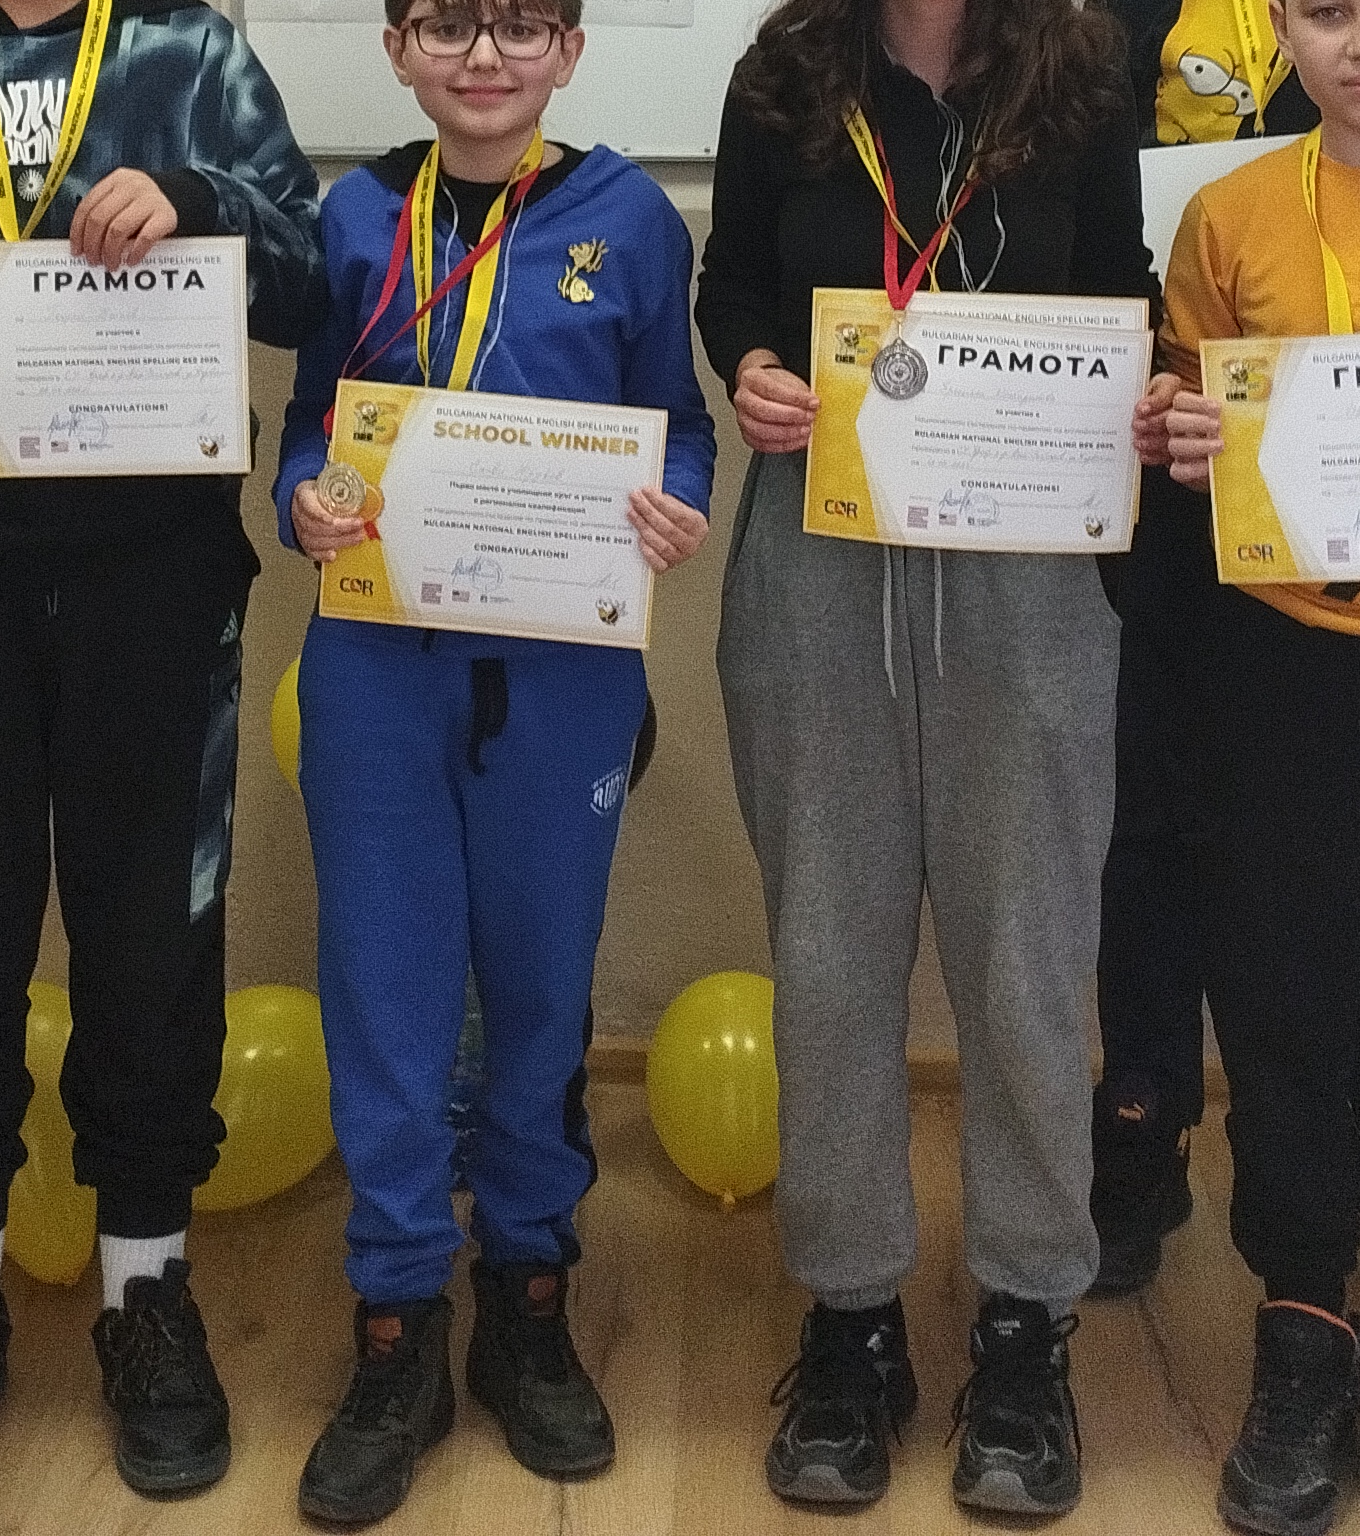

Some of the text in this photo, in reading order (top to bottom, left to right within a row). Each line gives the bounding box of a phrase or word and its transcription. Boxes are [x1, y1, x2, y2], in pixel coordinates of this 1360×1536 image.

[33, 268, 205, 293] ГРАМОТА
[938, 344, 1109, 379] ГРАМОТА
[436, 407, 639, 435] BULGARIAN NATIONAL ENGLISH SPELLING BEE
[433, 421, 639, 457] SCHOOL WINNER
